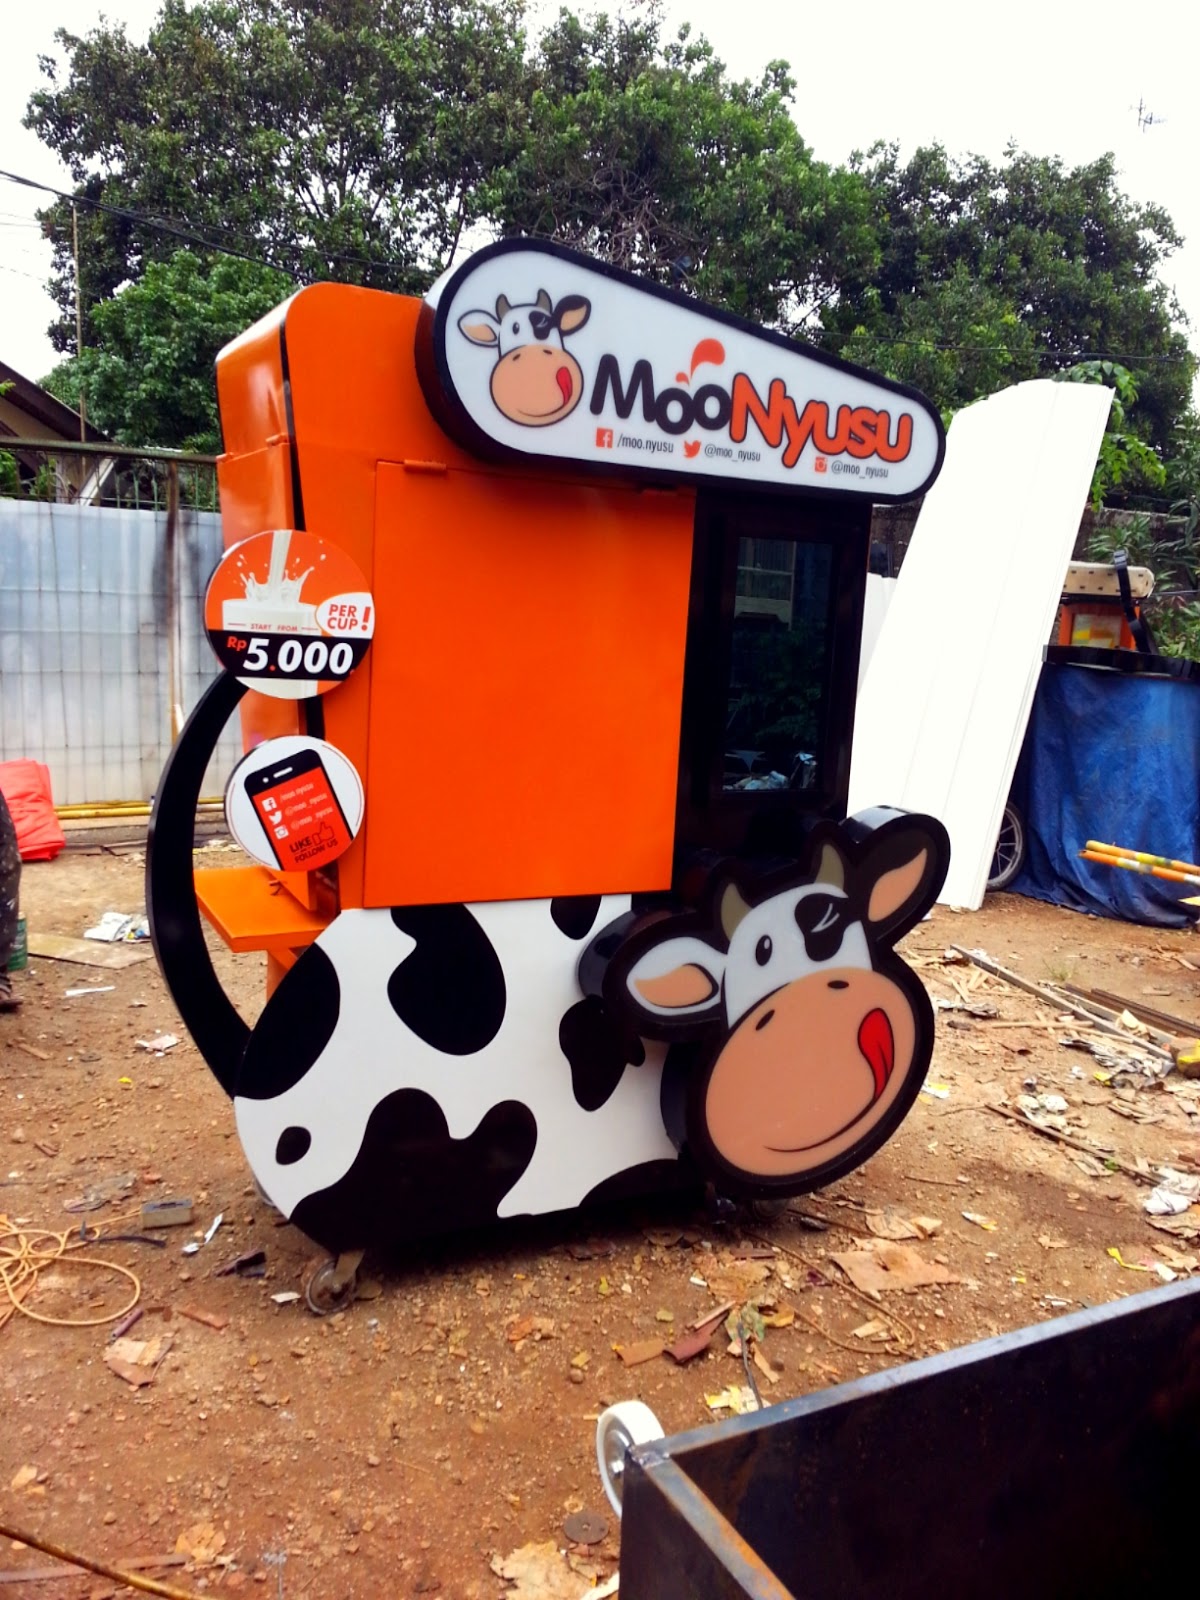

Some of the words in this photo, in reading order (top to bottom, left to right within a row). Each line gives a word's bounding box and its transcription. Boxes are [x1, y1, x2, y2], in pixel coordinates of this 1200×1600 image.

[704, 443, 762, 463] @moo_nyusu
[830, 460, 890, 479] @moo_nyusu
[328, 603, 358, 618] PER
[250, 622, 273, 631] START
[277, 624, 299, 632] FROM
[288, 836, 313, 853] LIKE
[294, 844, 326, 864] FOLLOW
[326, 838, 339, 848] US
